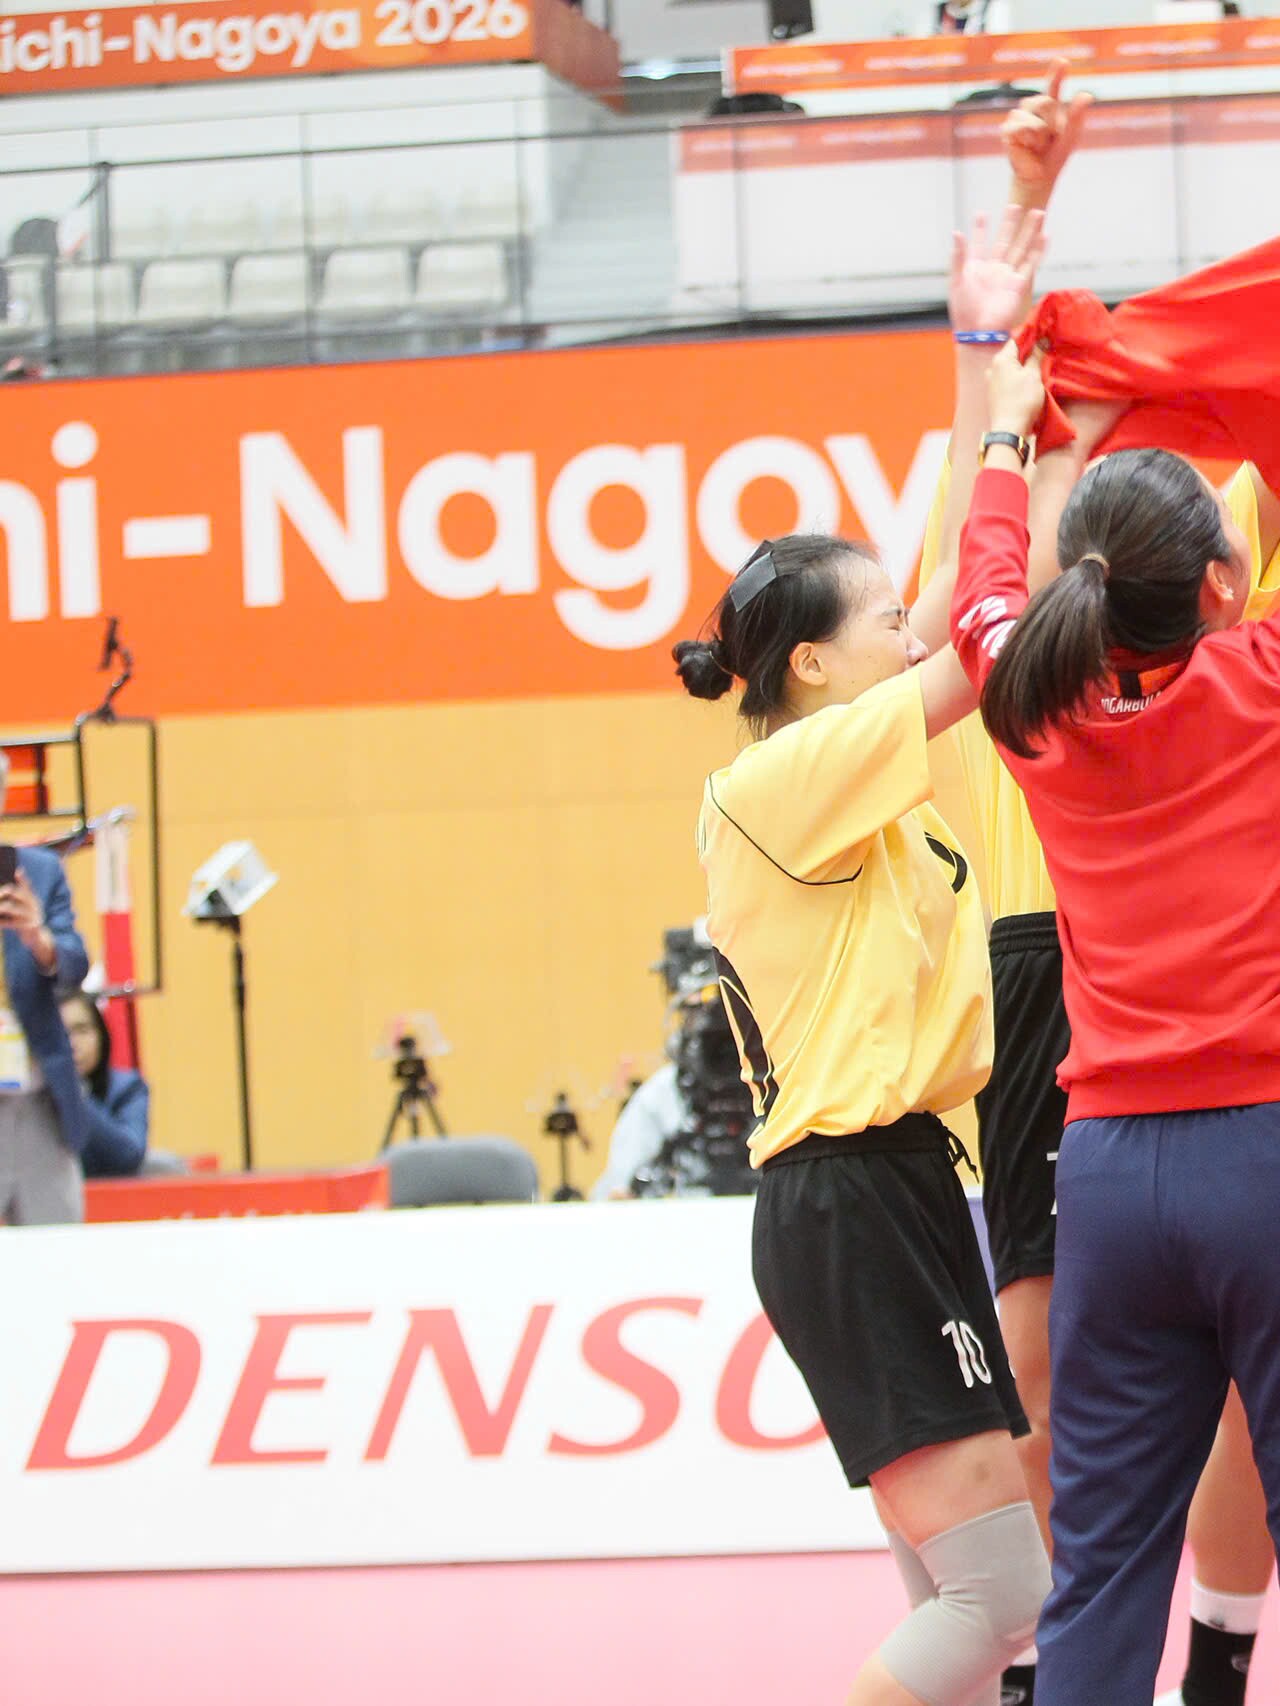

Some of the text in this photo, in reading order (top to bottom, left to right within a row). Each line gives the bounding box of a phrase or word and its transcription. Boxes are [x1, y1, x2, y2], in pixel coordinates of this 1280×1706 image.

[0, 0, 529, 73] ichi-Nagoya 2026
[941, 1320, 992, 1388] 10
